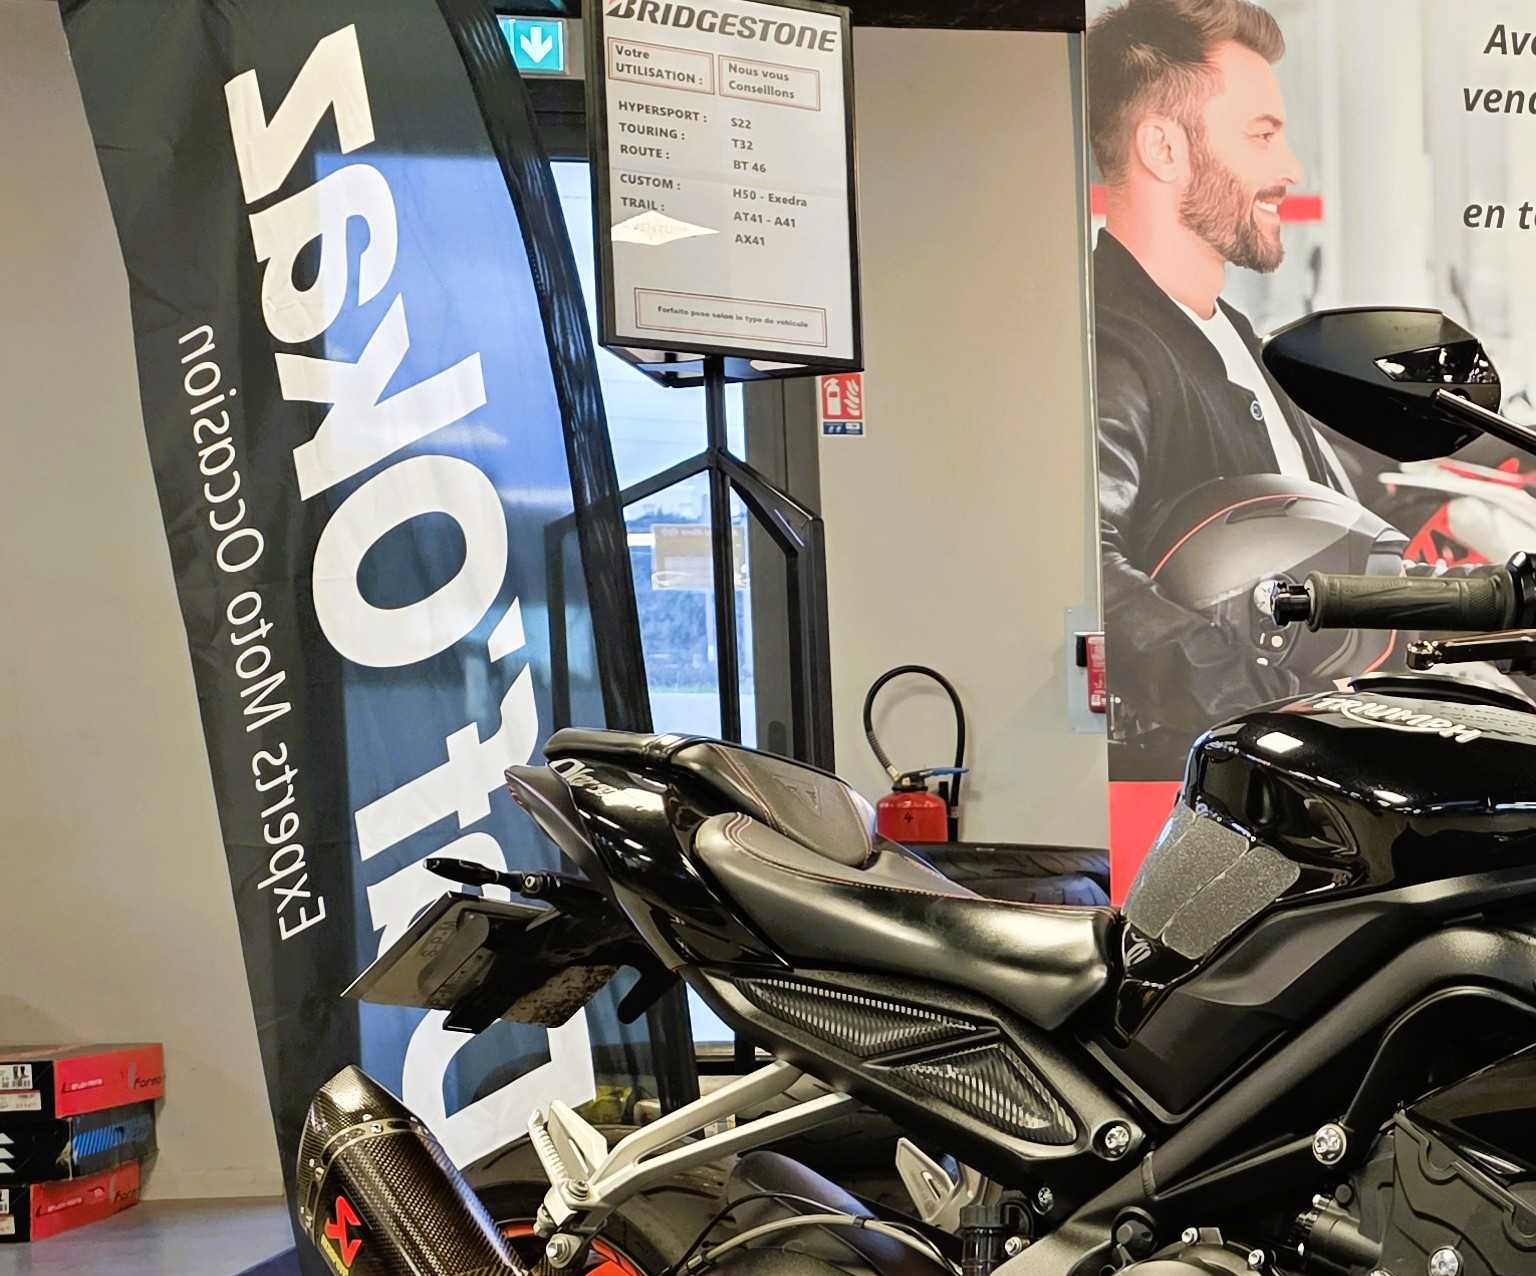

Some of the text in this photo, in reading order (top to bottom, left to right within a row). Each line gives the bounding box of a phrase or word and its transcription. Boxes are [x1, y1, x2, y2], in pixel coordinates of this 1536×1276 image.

[605, 0, 838, 52] BRIDGESTONE
[615, 44, 650, 60] Votre
[616, 63, 696, 84] UTILISATION
[729, 63, 789, 82] Nous vous
[729, 80, 795, 99] Conseillons
[618, 100, 700, 122] HYPERSPORT
[619, 122, 678, 140] TOURING
[731, 118, 752, 129] S22
[620, 144, 663, 159] ROUTE
[732, 138, 754, 151] T32
[733, 160, 767, 174] BT 46
[620, 174, 674, 190] CUSTOM
[620, 197, 659, 211] TRAIL
[733, 188, 757, 201] H50
[768, 193, 808, 208] Exedra
[734, 211, 763, 224] AT41
[774, 215, 796, 228] A41
[1462, 203, 1505, 230] en
[735, 233, 766, 247] AX41
